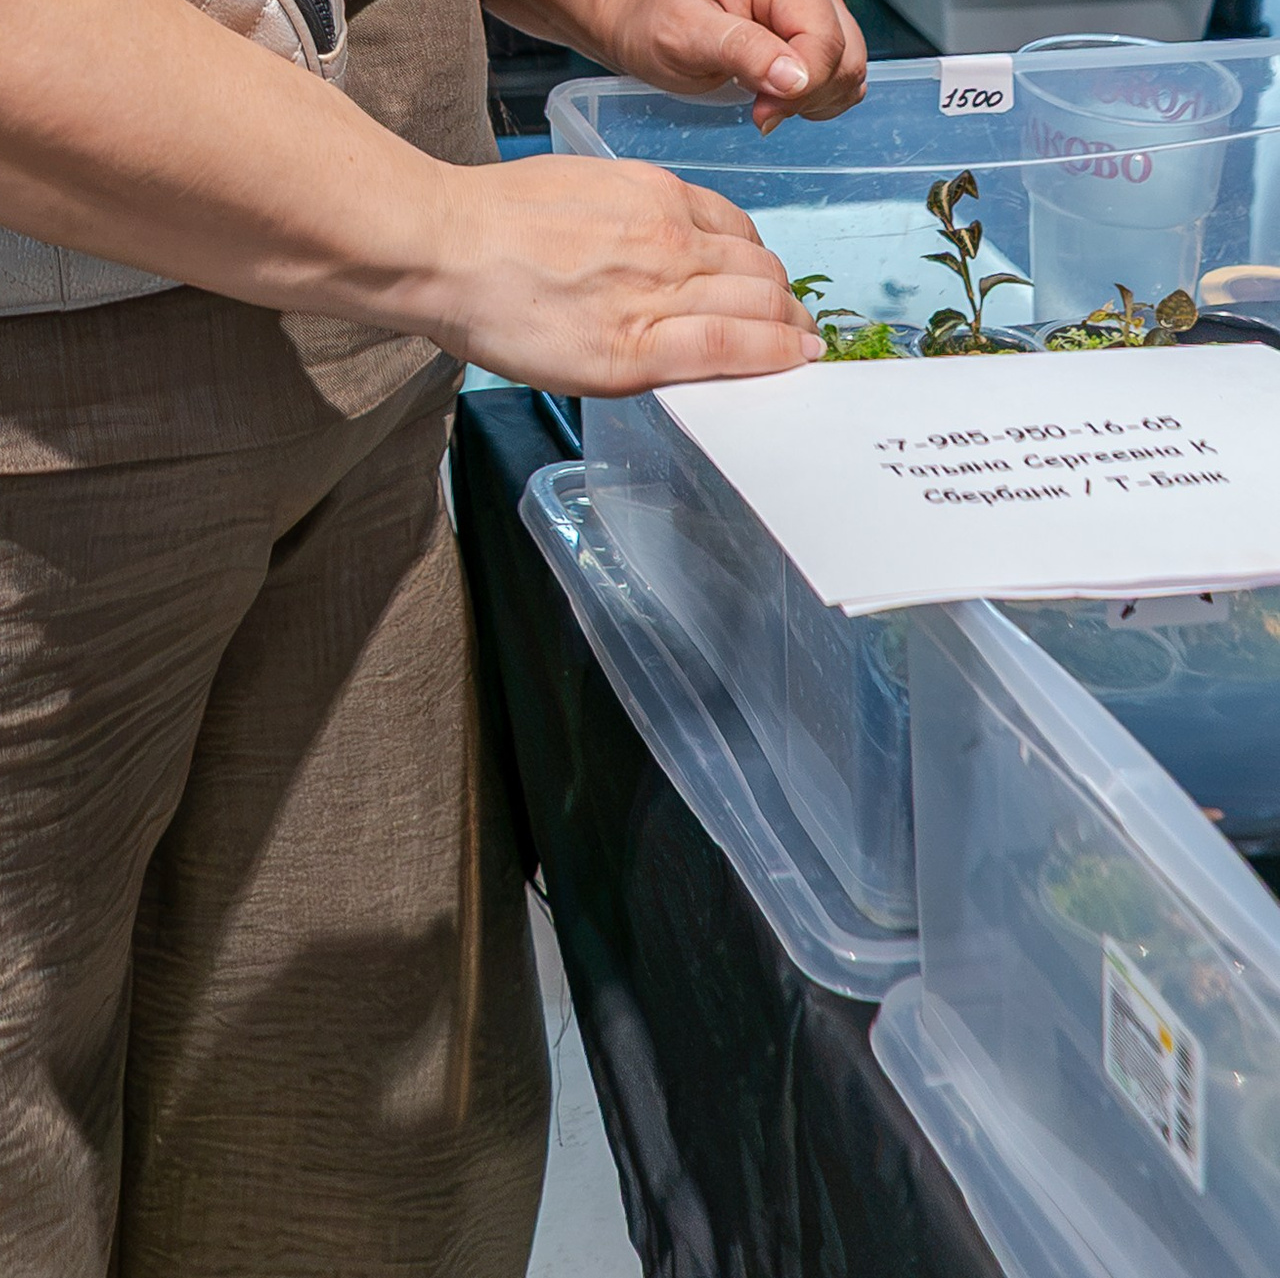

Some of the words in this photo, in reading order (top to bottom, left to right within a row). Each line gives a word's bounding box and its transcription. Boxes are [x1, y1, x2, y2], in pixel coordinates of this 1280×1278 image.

[941, 88, 1004, 109] 1500
[873, 415, 1182, 452] +7-985-950-16-65
[879, 459, 1013, 478] Татьяна
[1022, 446, 1185, 472] Сергеевна
[1187, 439, 1218, 456] К
[922, 484, 1072, 508] Сбербанк
[1104, 470, 1231, 493] Т-Банк
